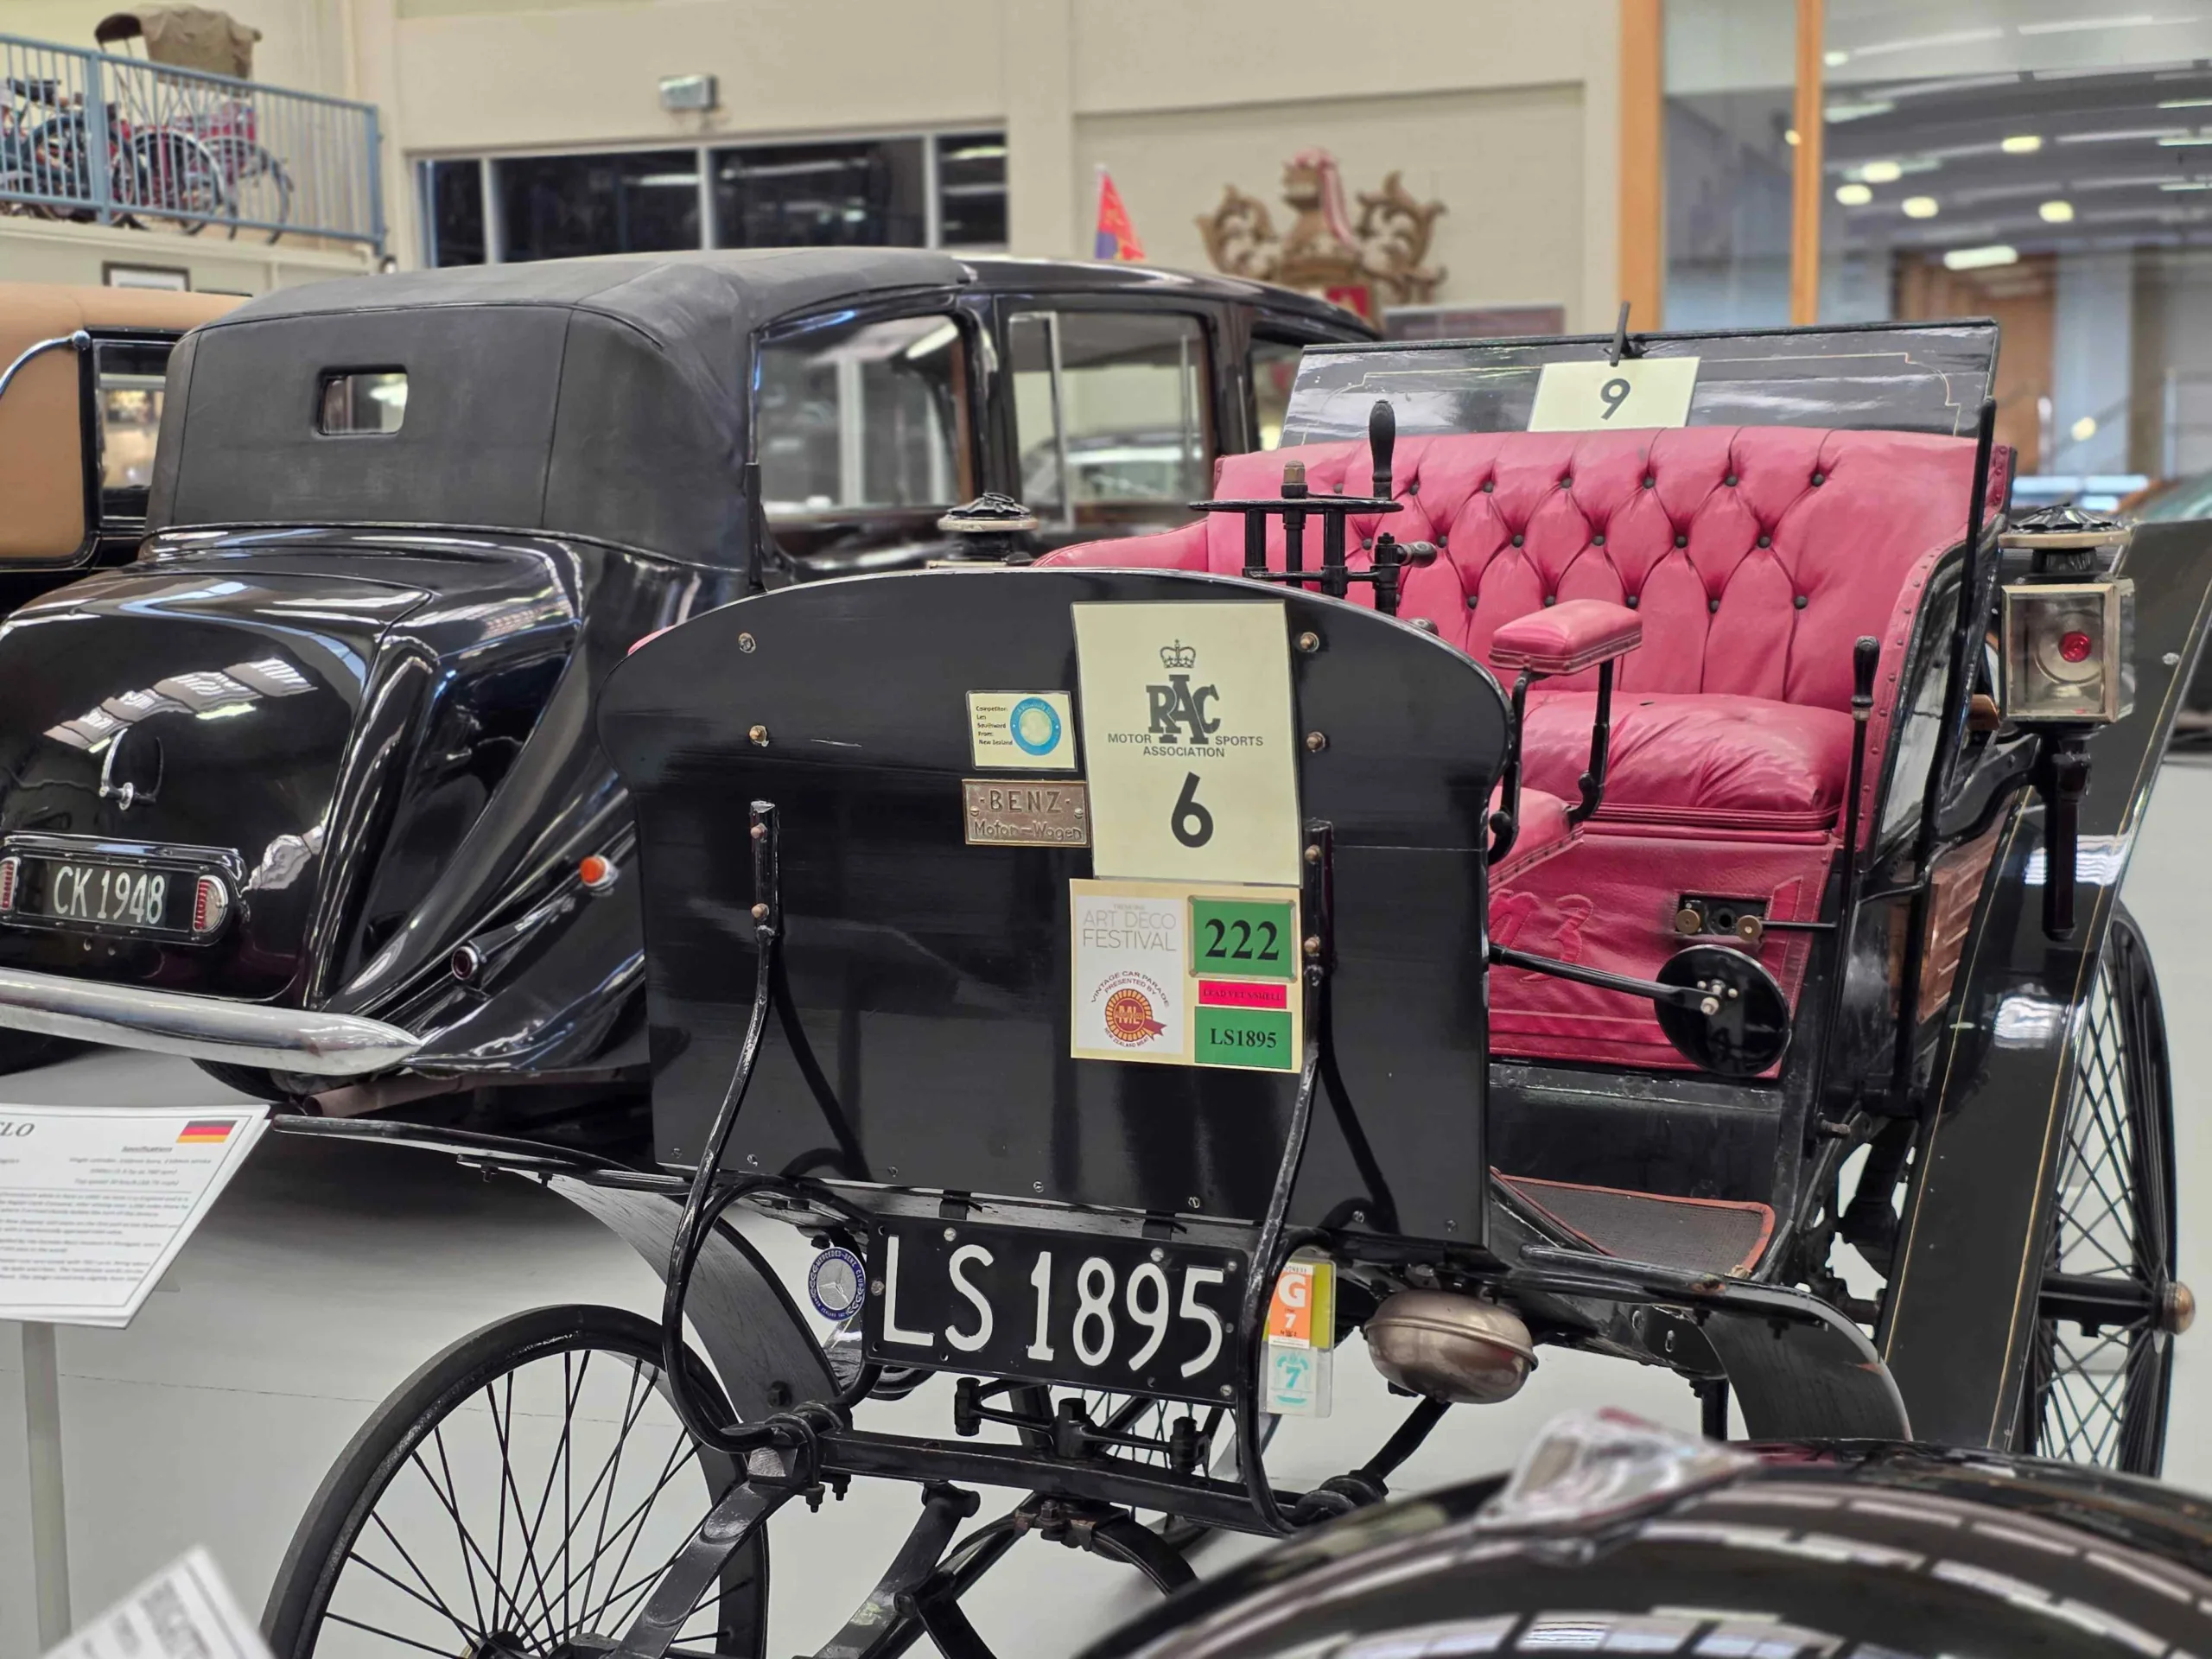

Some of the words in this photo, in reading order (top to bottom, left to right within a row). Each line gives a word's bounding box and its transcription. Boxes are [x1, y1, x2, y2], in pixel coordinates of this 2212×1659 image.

[1600, 378, 1630, 421] 9
[1146, 674, 1221, 745] RAC
[1108, 733, 1152, 744] MOTOR
[1215, 735, 1263, 747] SPORTS
[1143, 746, 1225, 758] ASSOCIATION
[988, 788, 1063, 813] BENZ
[1171, 772, 1214, 848] 6
[54, 866, 93, 918] CK
[97, 869, 165, 925] 1948
[1083, 909, 1118, 928] ART
[1124, 911, 1177, 930] DECO
[1083, 928, 1178, 952] FESTIVAL
[1205, 918, 1280, 961] 222
[1090, 971, 1121, 1003] VINTAGE
[1141, 974, 1170, 1008] PARADE
[1104, 978, 1147, 995] PRESENTED
[1146, 984, 1157, 995] BY
[1103, 1027, 1114, 1039] NEW
[1113, 1038, 1136, 1047] ZEALAND
[1210, 1027, 1277, 1048] LS1895
[0, 1122, 35, 1137] LO
[855, 1269, 864, 1287] CLUB
[1278, 1273, 1306, 1308] G
[883, 1236, 995, 1352] LS
[1027, 1250, 1225, 1379] 1895
[1285, 1313, 1297, 1329] 7
[1285, 1365, 1301, 1389] 7
